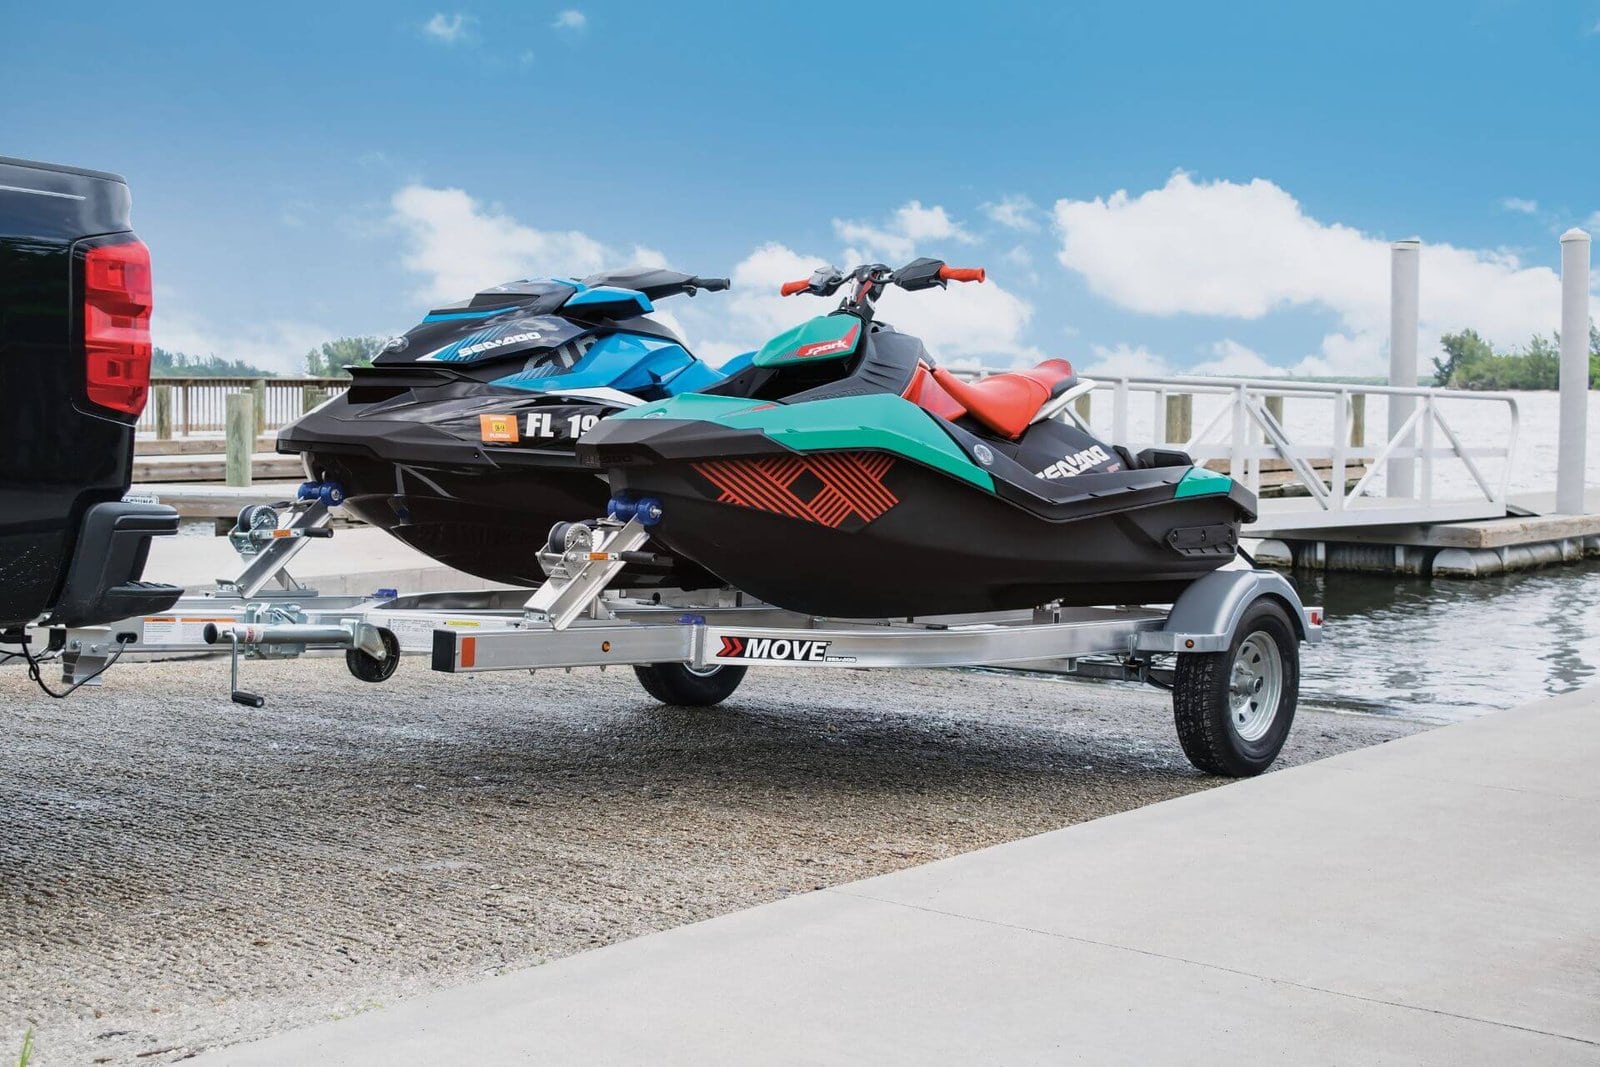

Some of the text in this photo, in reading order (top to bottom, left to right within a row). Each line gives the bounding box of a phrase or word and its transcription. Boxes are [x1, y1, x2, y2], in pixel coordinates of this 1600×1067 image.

[525, 413, 607, 438] FL 19
[744, 638, 827, 661] MOVE
